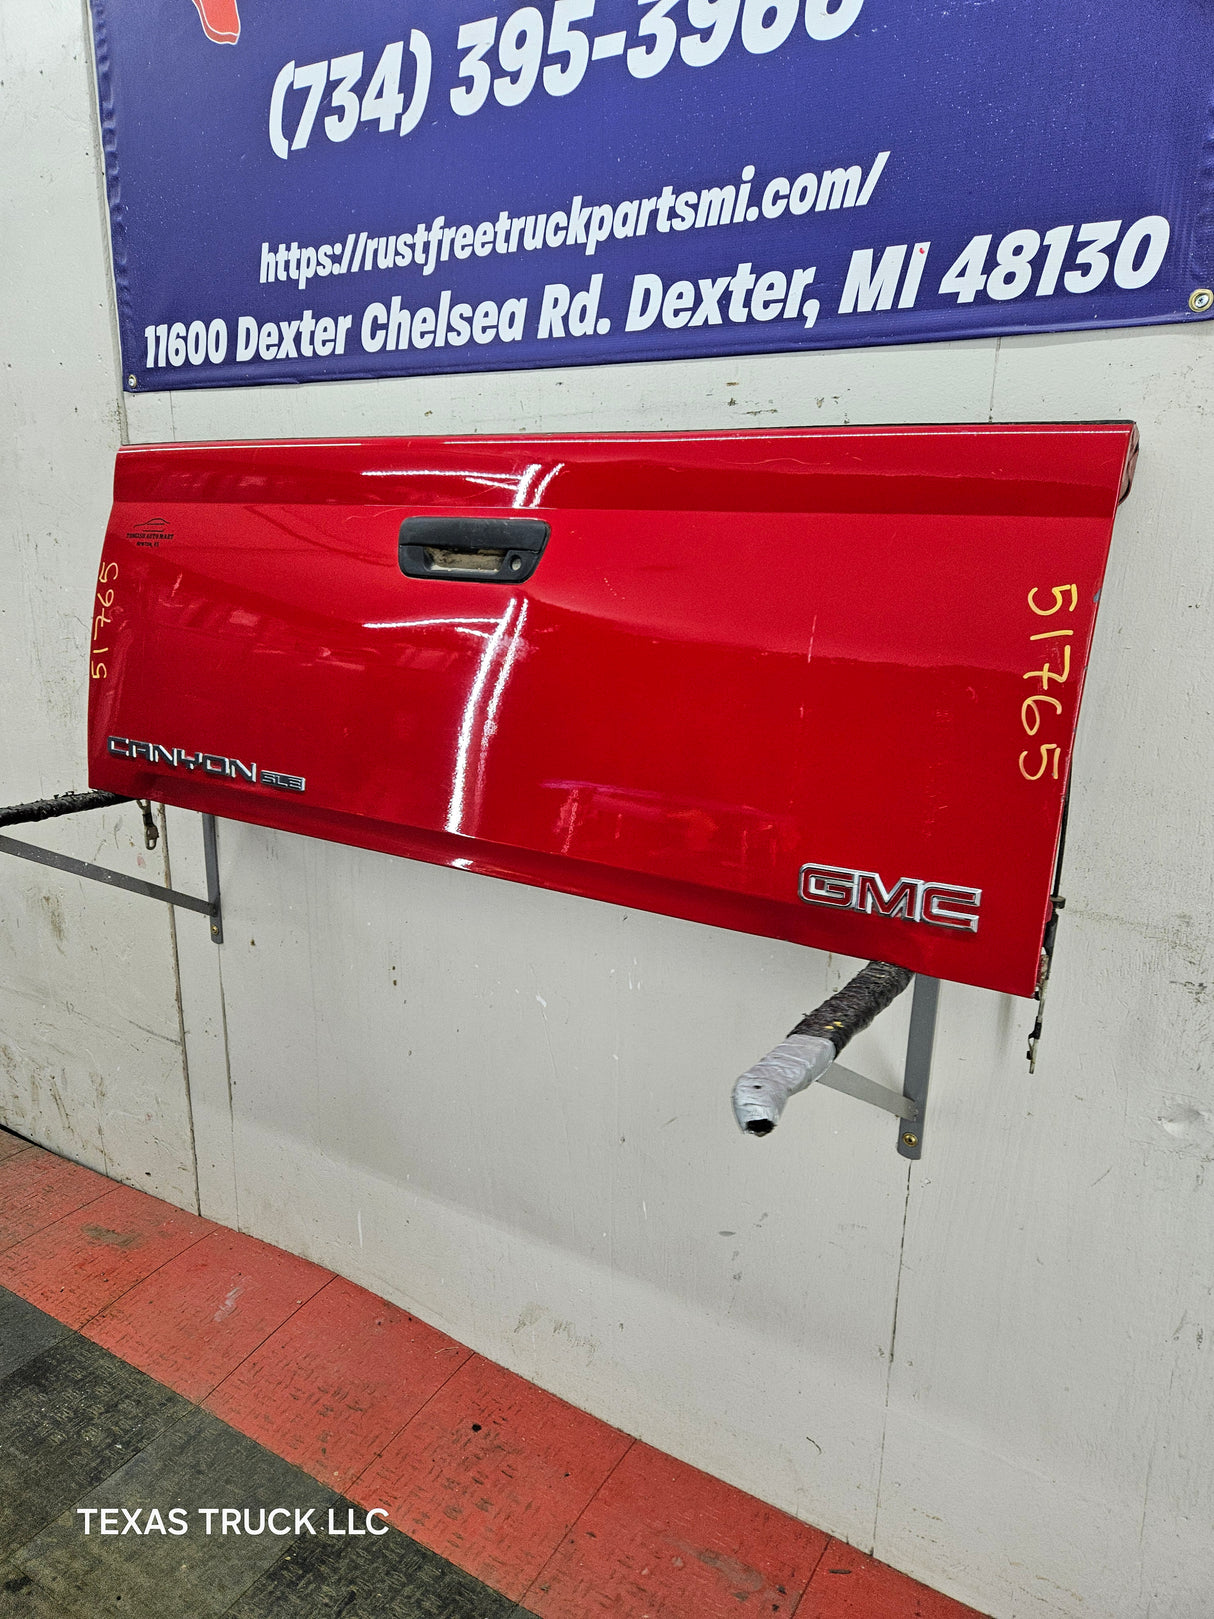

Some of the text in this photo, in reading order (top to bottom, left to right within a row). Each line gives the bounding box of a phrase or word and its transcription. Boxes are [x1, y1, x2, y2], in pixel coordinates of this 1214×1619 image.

[268, 28, 432, 160] (734)
[259, 150, 891, 290] https://rustfreetruckpartsmi.com/
[144, 215, 1171, 368] 11600 Dexter Chelsea Rd. Dexter, MI 48130
[91, 561, 120, 680] 51765
[1018, 583, 1078, 781] 51765
[107, 735, 258, 783] CANYON
[798, 862, 983, 933] GMC
